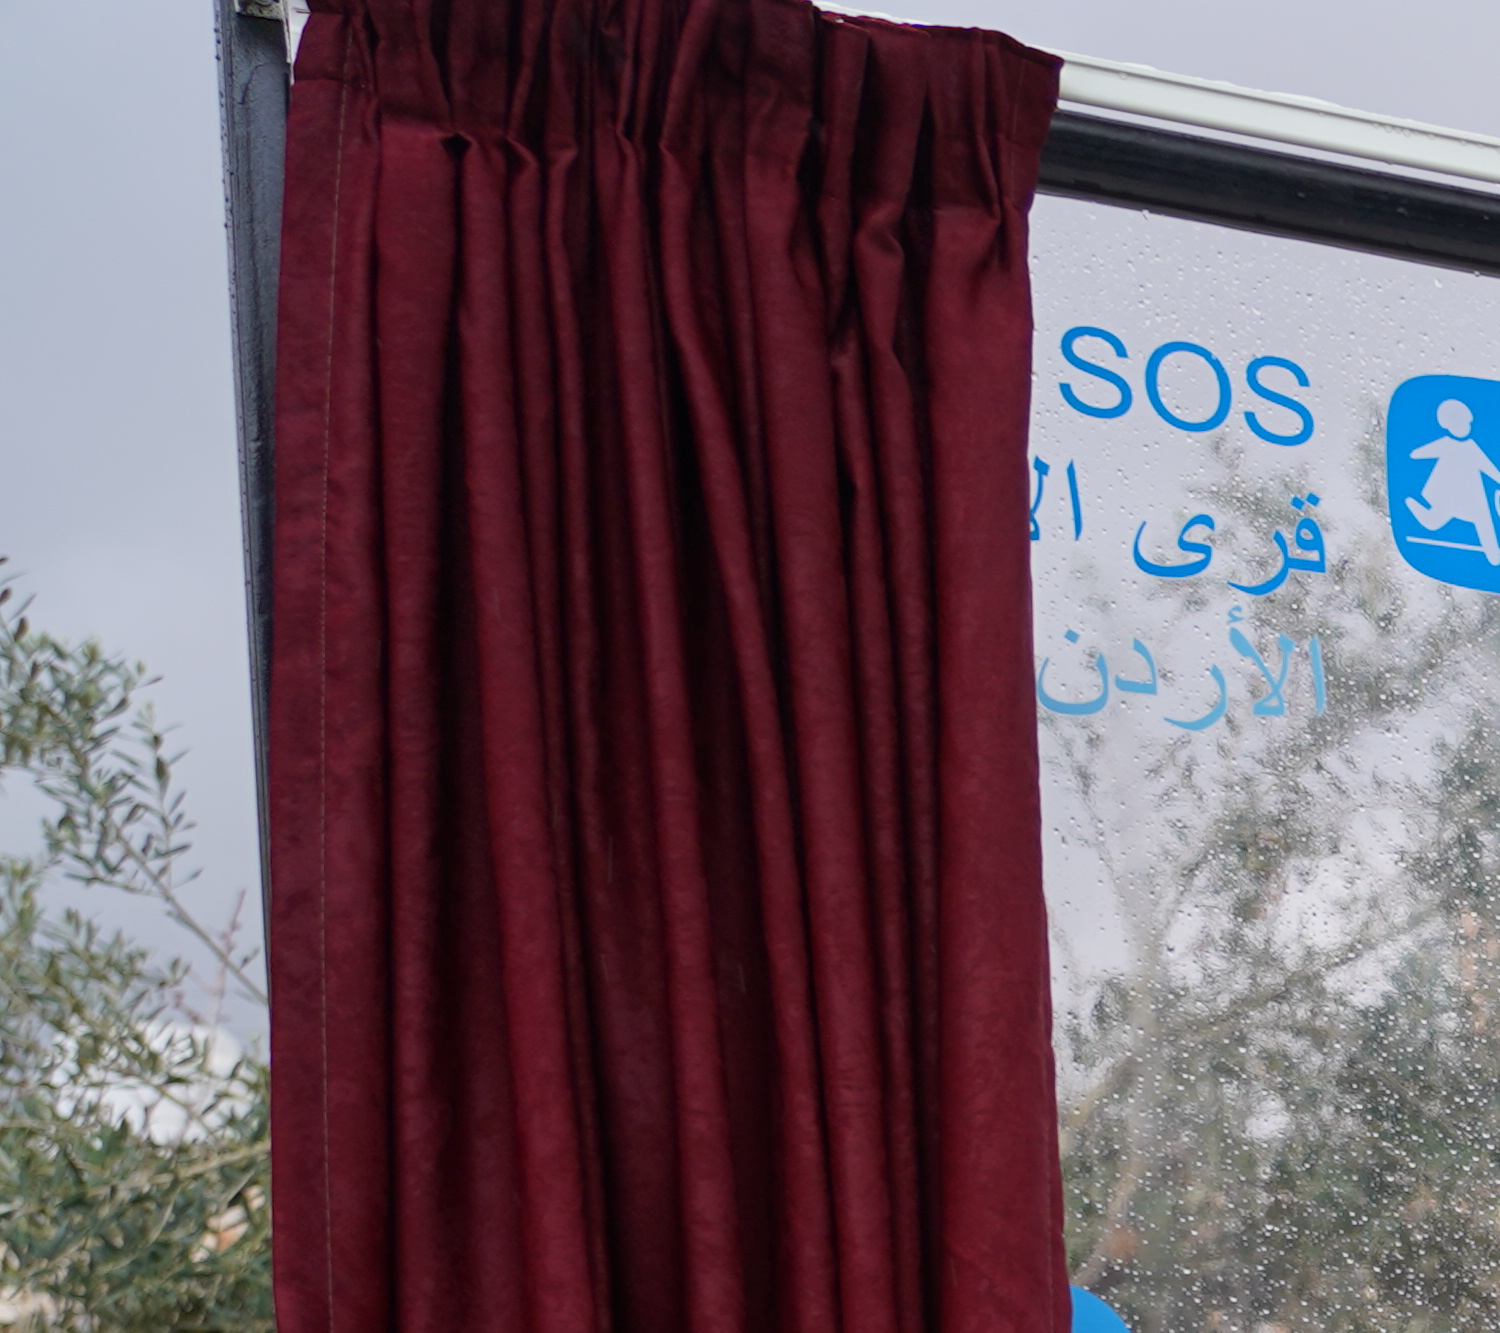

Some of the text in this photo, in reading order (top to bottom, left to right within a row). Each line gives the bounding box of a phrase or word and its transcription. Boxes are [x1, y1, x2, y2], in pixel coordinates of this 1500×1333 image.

[1059, 325, 1315, 447] SOS
[1132, 491, 1327, 597] قرى
[1036, 603, 1326, 732] الأردن
